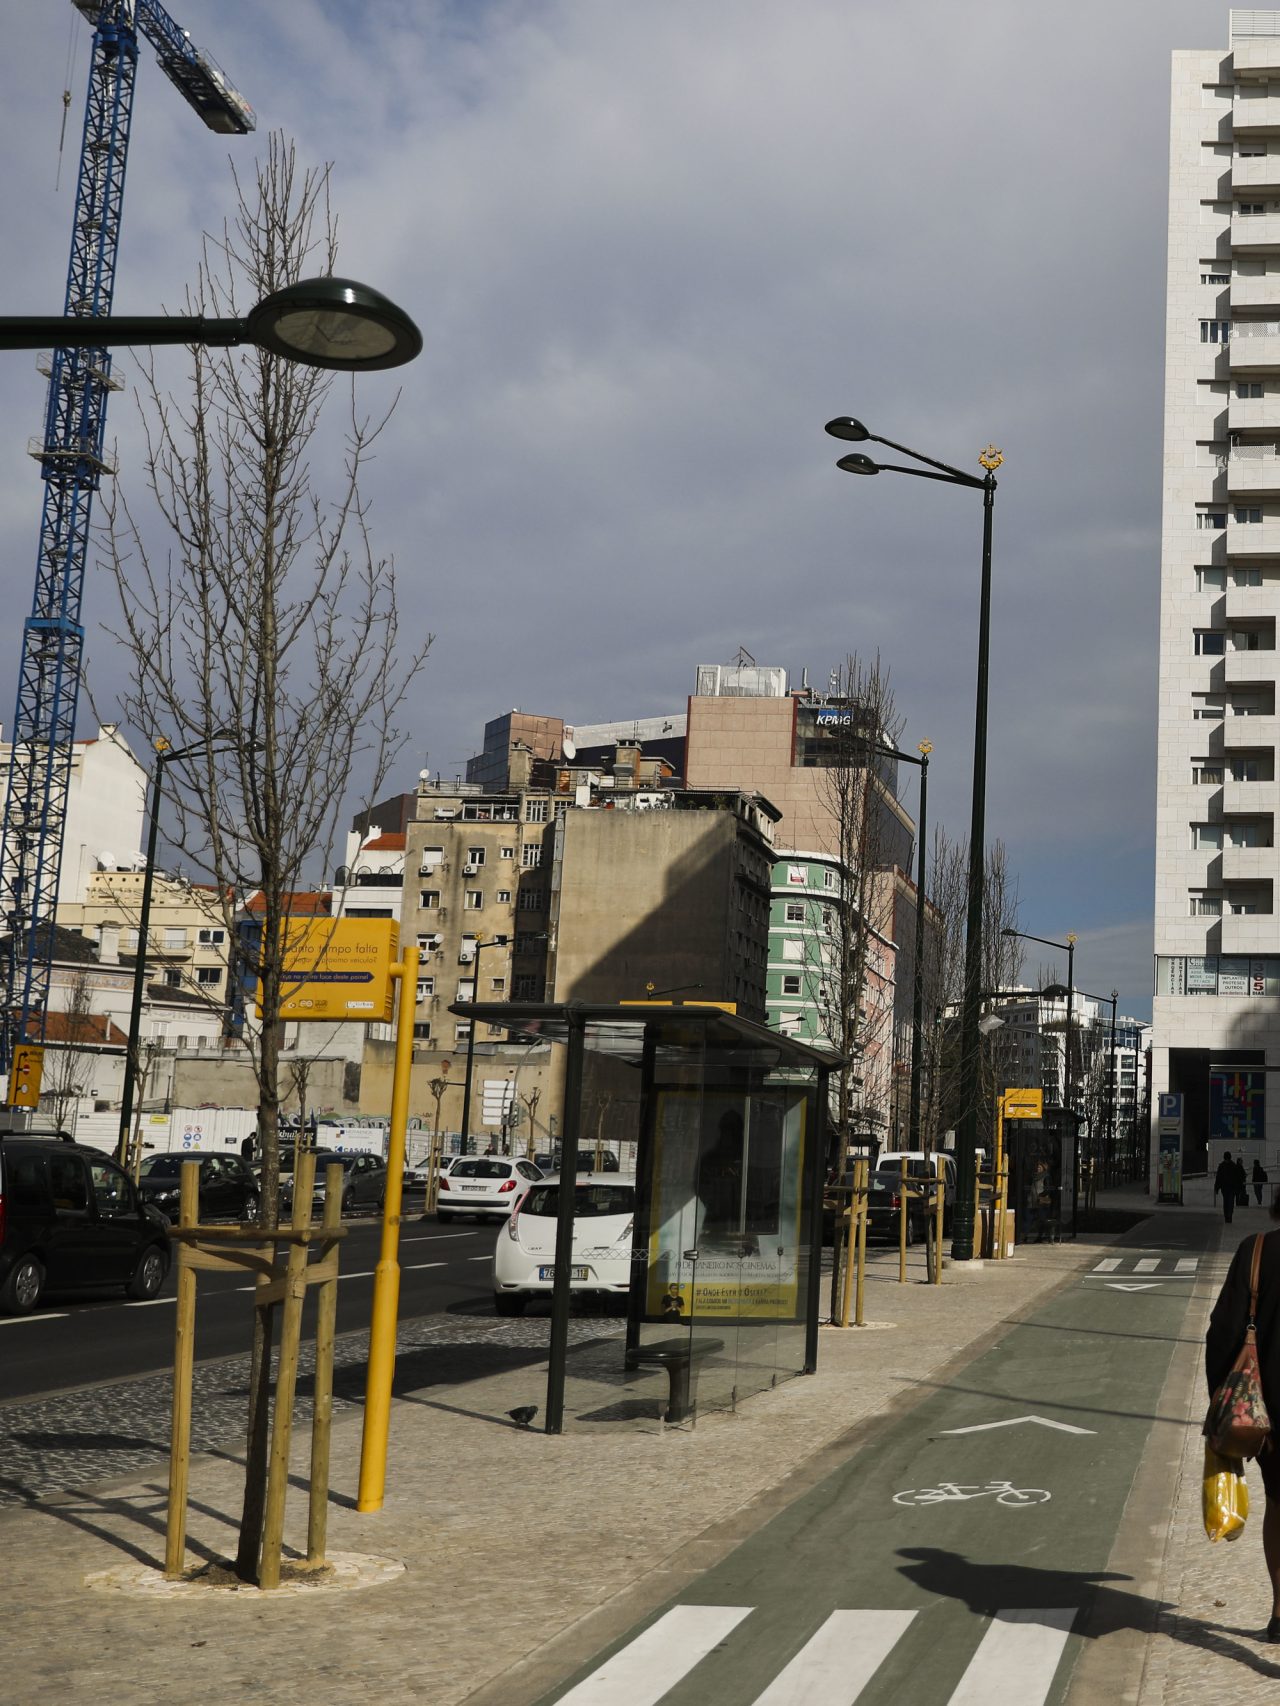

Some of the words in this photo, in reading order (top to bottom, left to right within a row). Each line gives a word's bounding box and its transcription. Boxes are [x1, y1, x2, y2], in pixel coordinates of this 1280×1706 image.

[815, 715, 851, 725] KPMG
[319, 943, 352, 956] tmpo
[356, 943, 378, 954] falta
[1163, 1095, 1177, 1116] P
